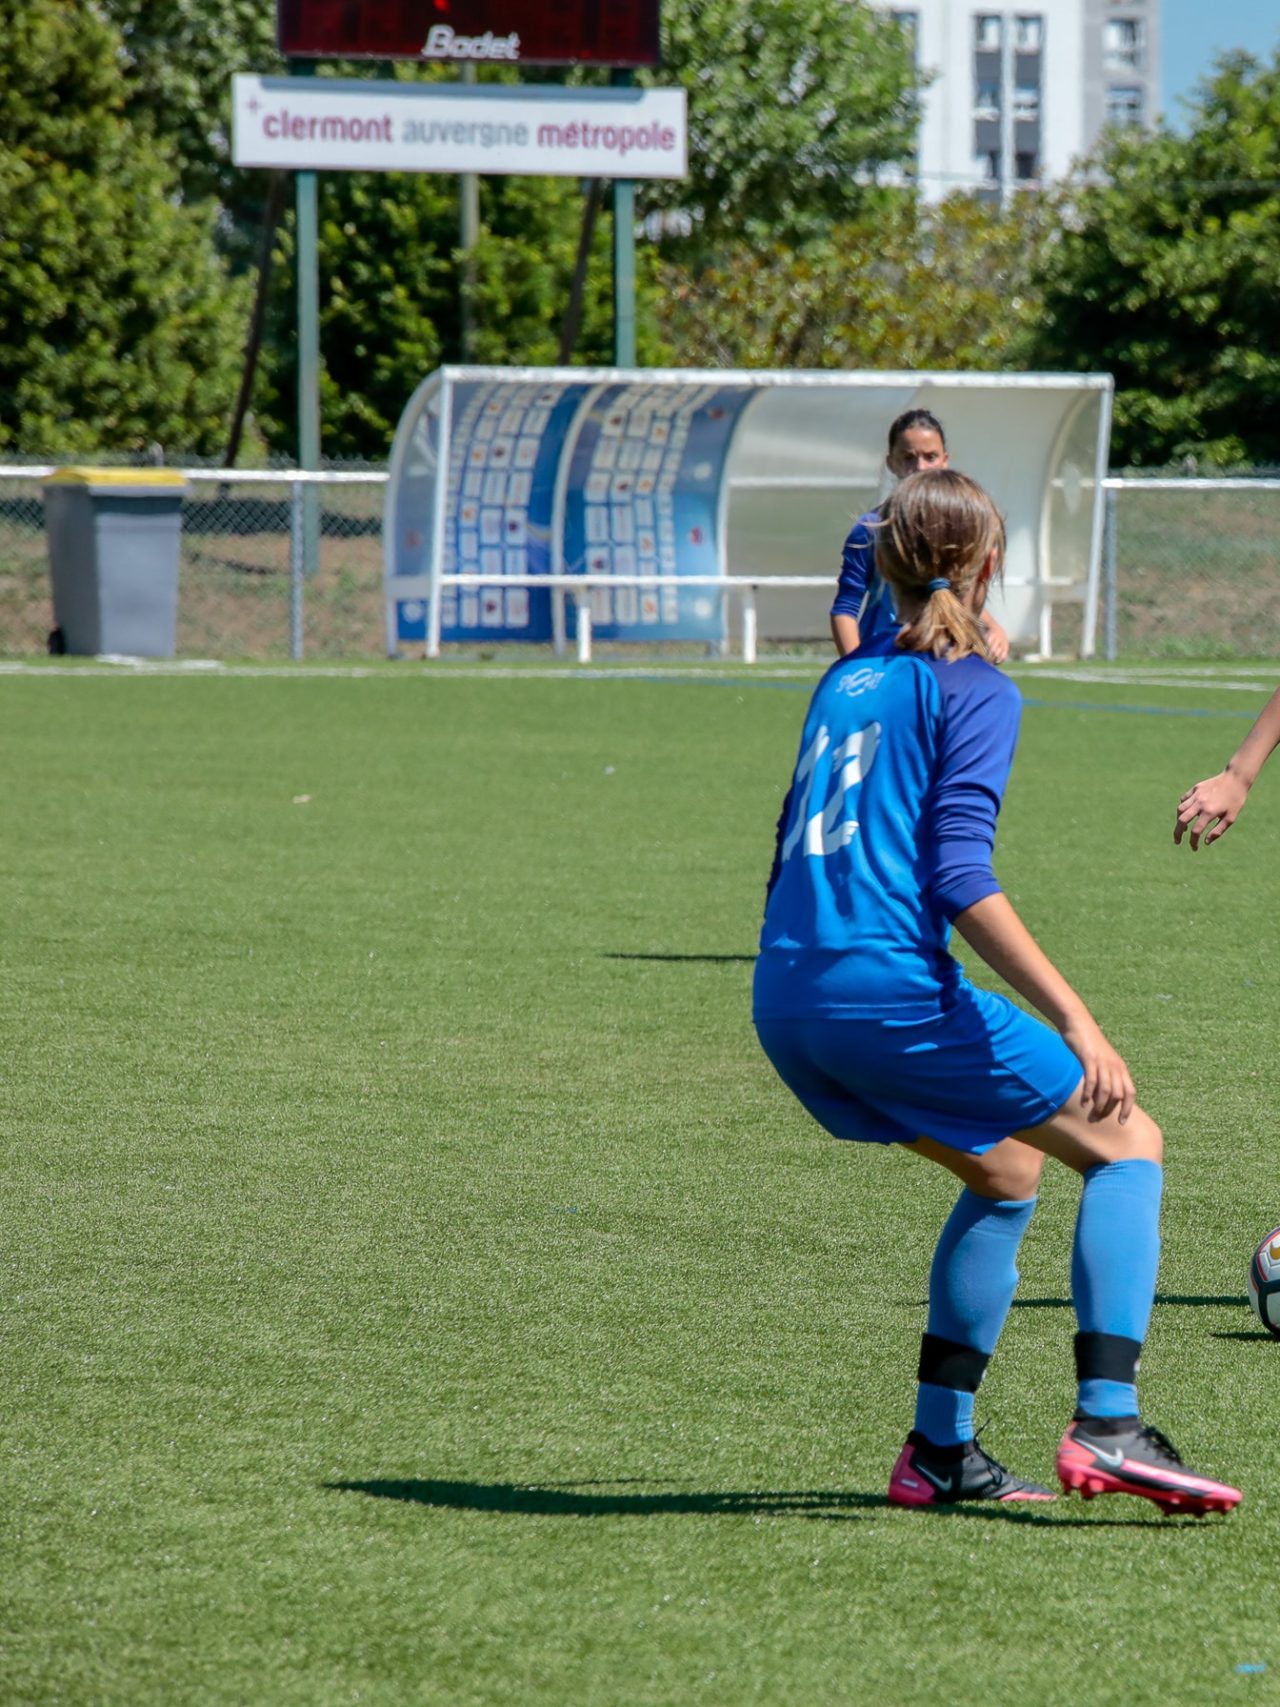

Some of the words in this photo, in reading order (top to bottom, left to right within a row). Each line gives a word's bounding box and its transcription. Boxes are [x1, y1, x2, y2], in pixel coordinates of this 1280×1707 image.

[421, 24, 521, 60] Bodet
[262, 108, 393, 143] clermont
[402, 118, 529, 149] auvergne
[537, 120, 676, 157] métropole
[782, 721, 882, 863] 12
